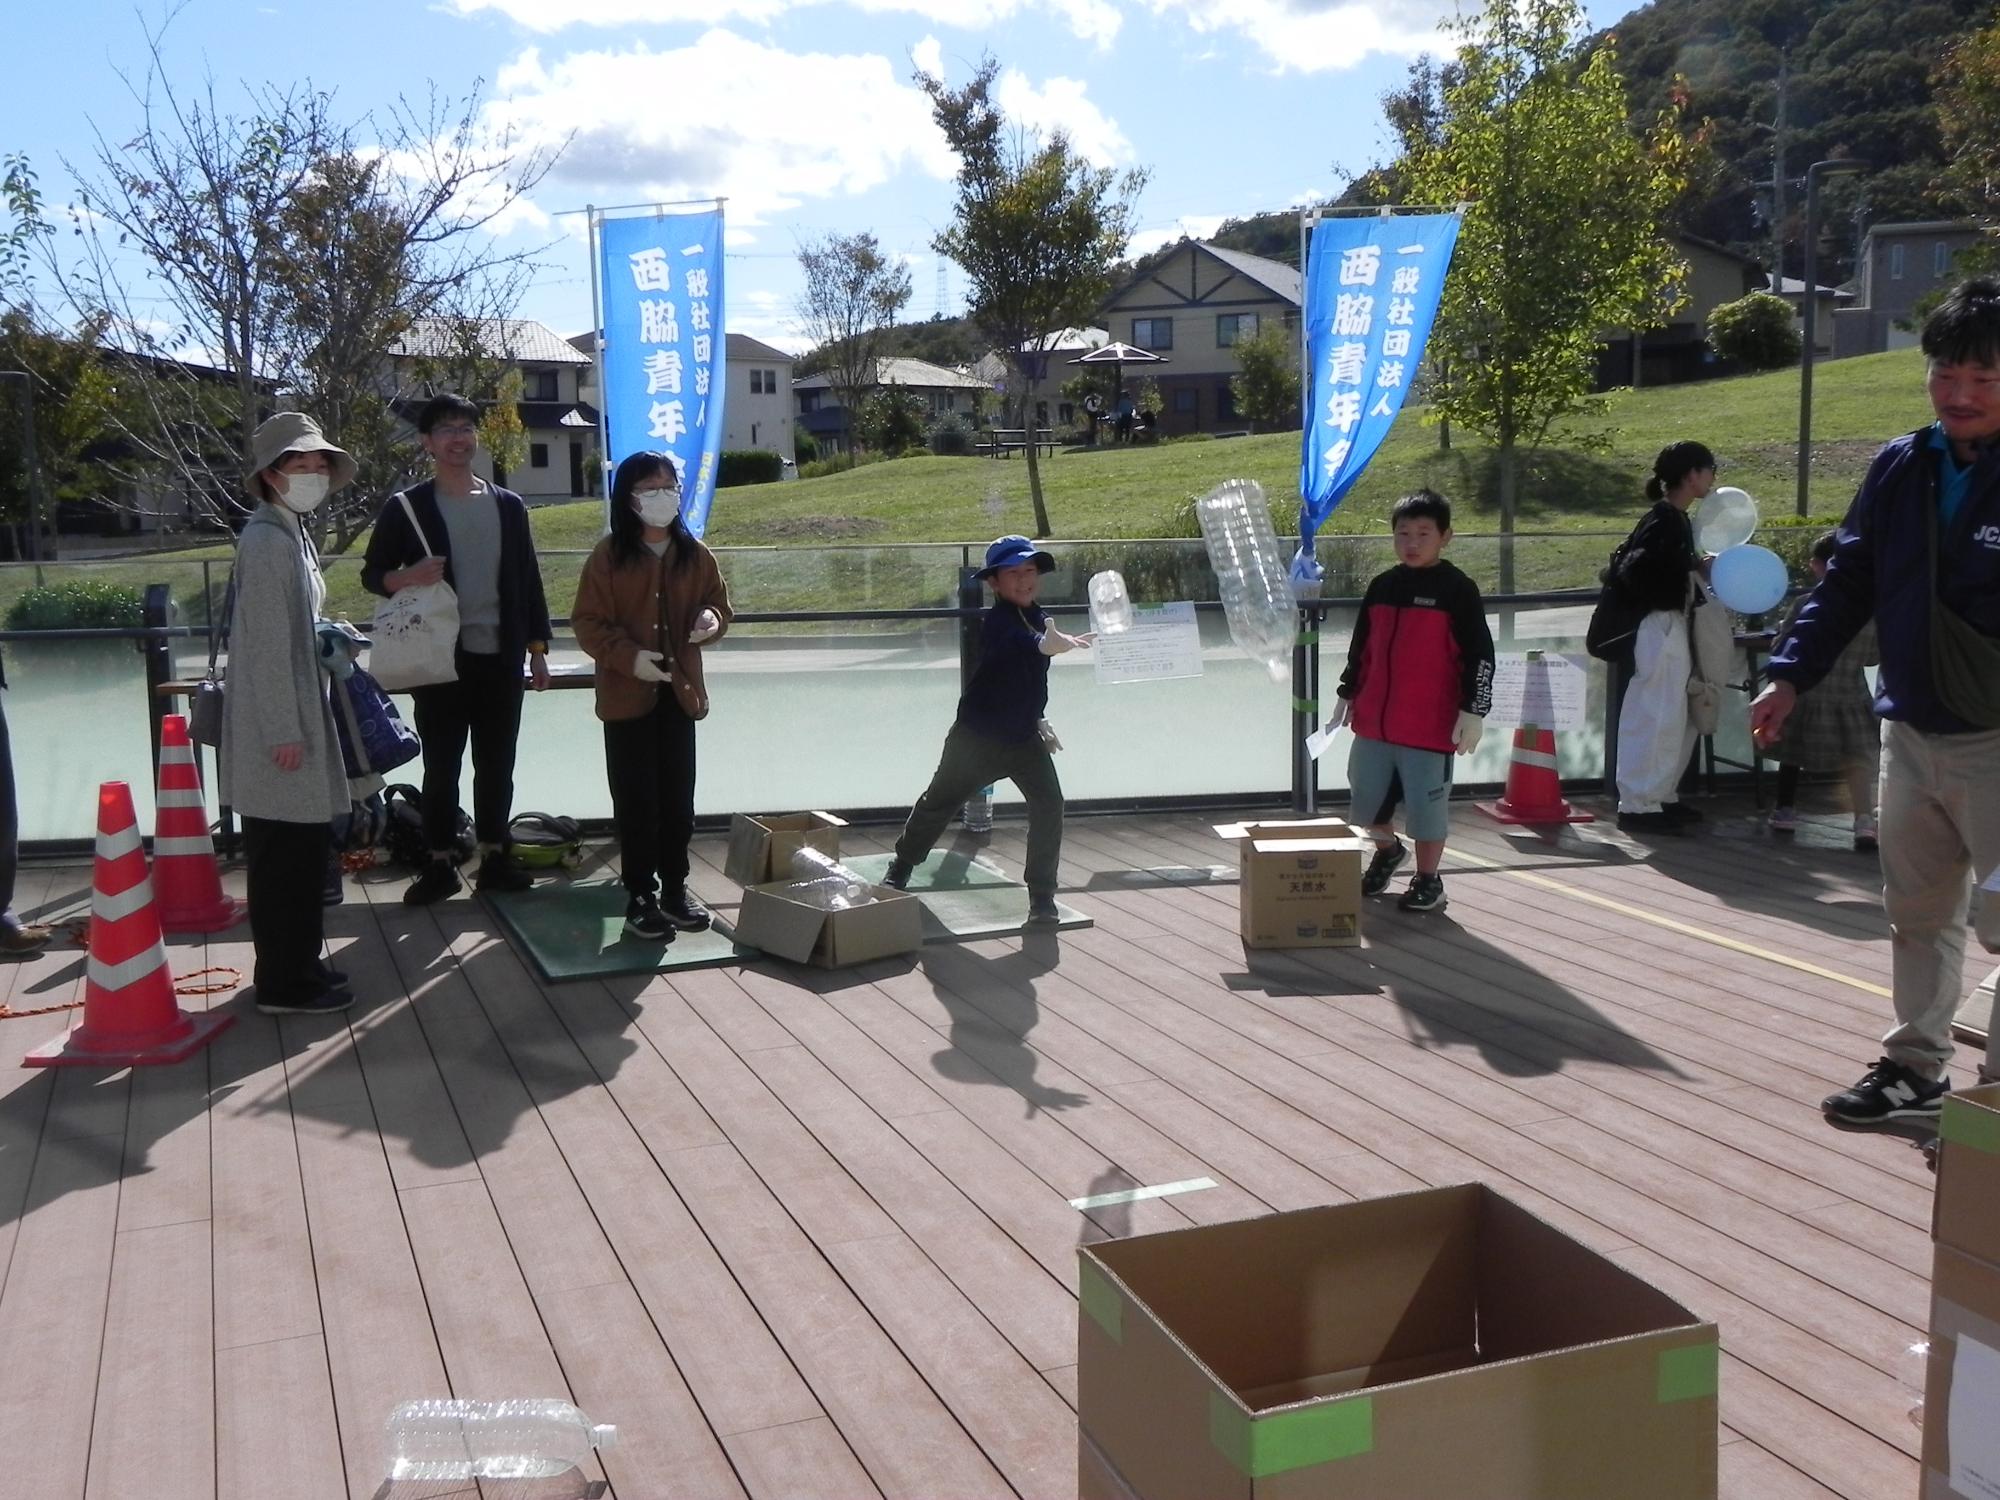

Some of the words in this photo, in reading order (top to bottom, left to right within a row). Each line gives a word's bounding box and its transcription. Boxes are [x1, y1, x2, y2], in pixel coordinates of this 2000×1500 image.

[680, 243, 711, 428] 一般社団法人
[1370, 243, 1424, 417] 一般社団法人
[1973, 525, 2000, 543] JC
